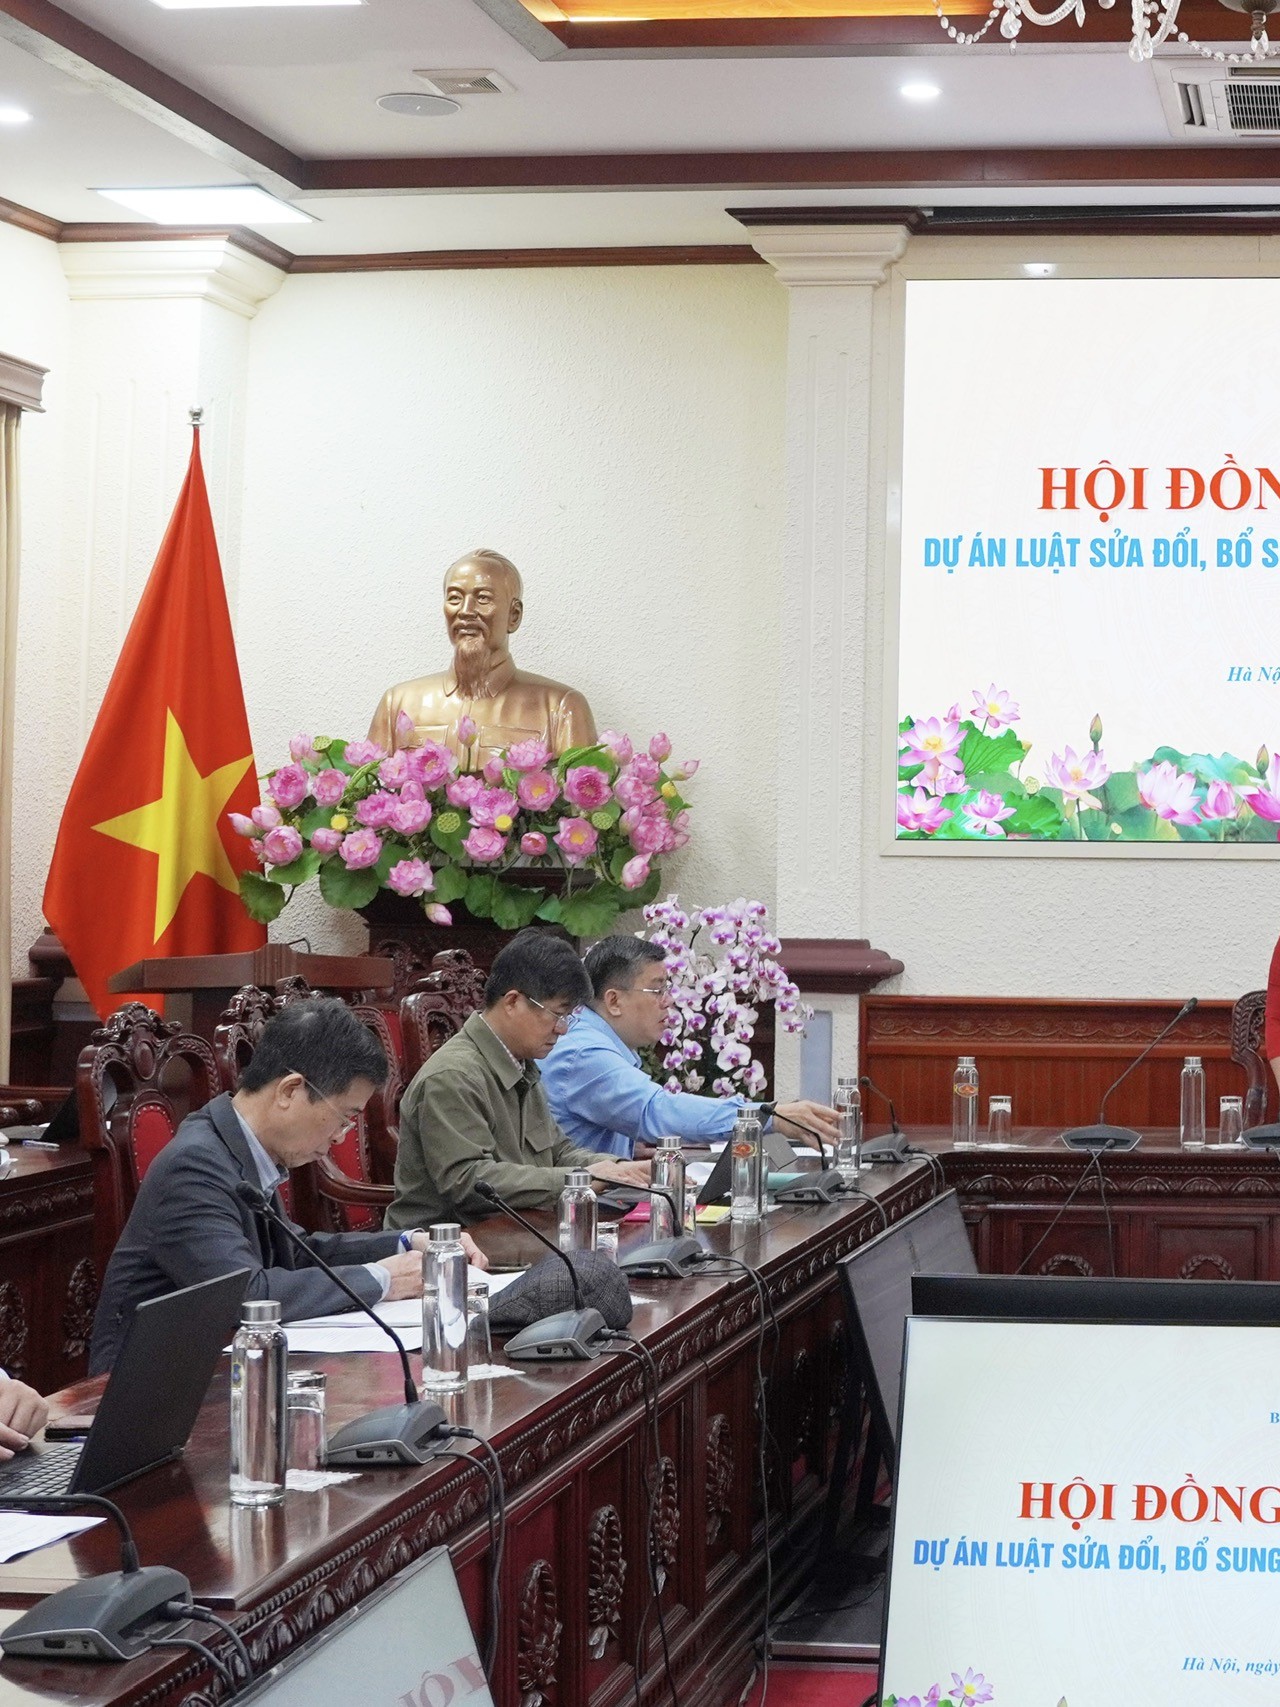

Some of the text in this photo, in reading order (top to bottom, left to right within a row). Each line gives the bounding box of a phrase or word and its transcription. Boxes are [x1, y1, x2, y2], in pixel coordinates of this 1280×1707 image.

[1037, 459, 1149, 523] HỘI
[924, 535, 963, 573] DỰ
[968, 532, 1006, 567] ÁN
[1016, 532, 1080, 574] LUẬT
[1090, 528, 1144, 567] SỬA
[1153, 526, 1206, 571] ĐỔI,
[1217, 526, 1253, 568] BỔ
[1227, 667, 1252, 681] Hà
[1017, 1476, 1117, 1531] HỘI
[913, 1538, 949, 1571] DỰ
[953, 1536, 988, 1566] ÁN
[996, 1538, 1054, 1573] LUẬT
[1061, 1536, 1110, 1569] SỬA
[1119, 1535, 1166, 1573] ĐỔI,
[1175, 1537, 1210, 1571] BỔ
[1182, 1657, 1204, 1671] Hà
[1209, 1658, 1240, 1674] Nội,
